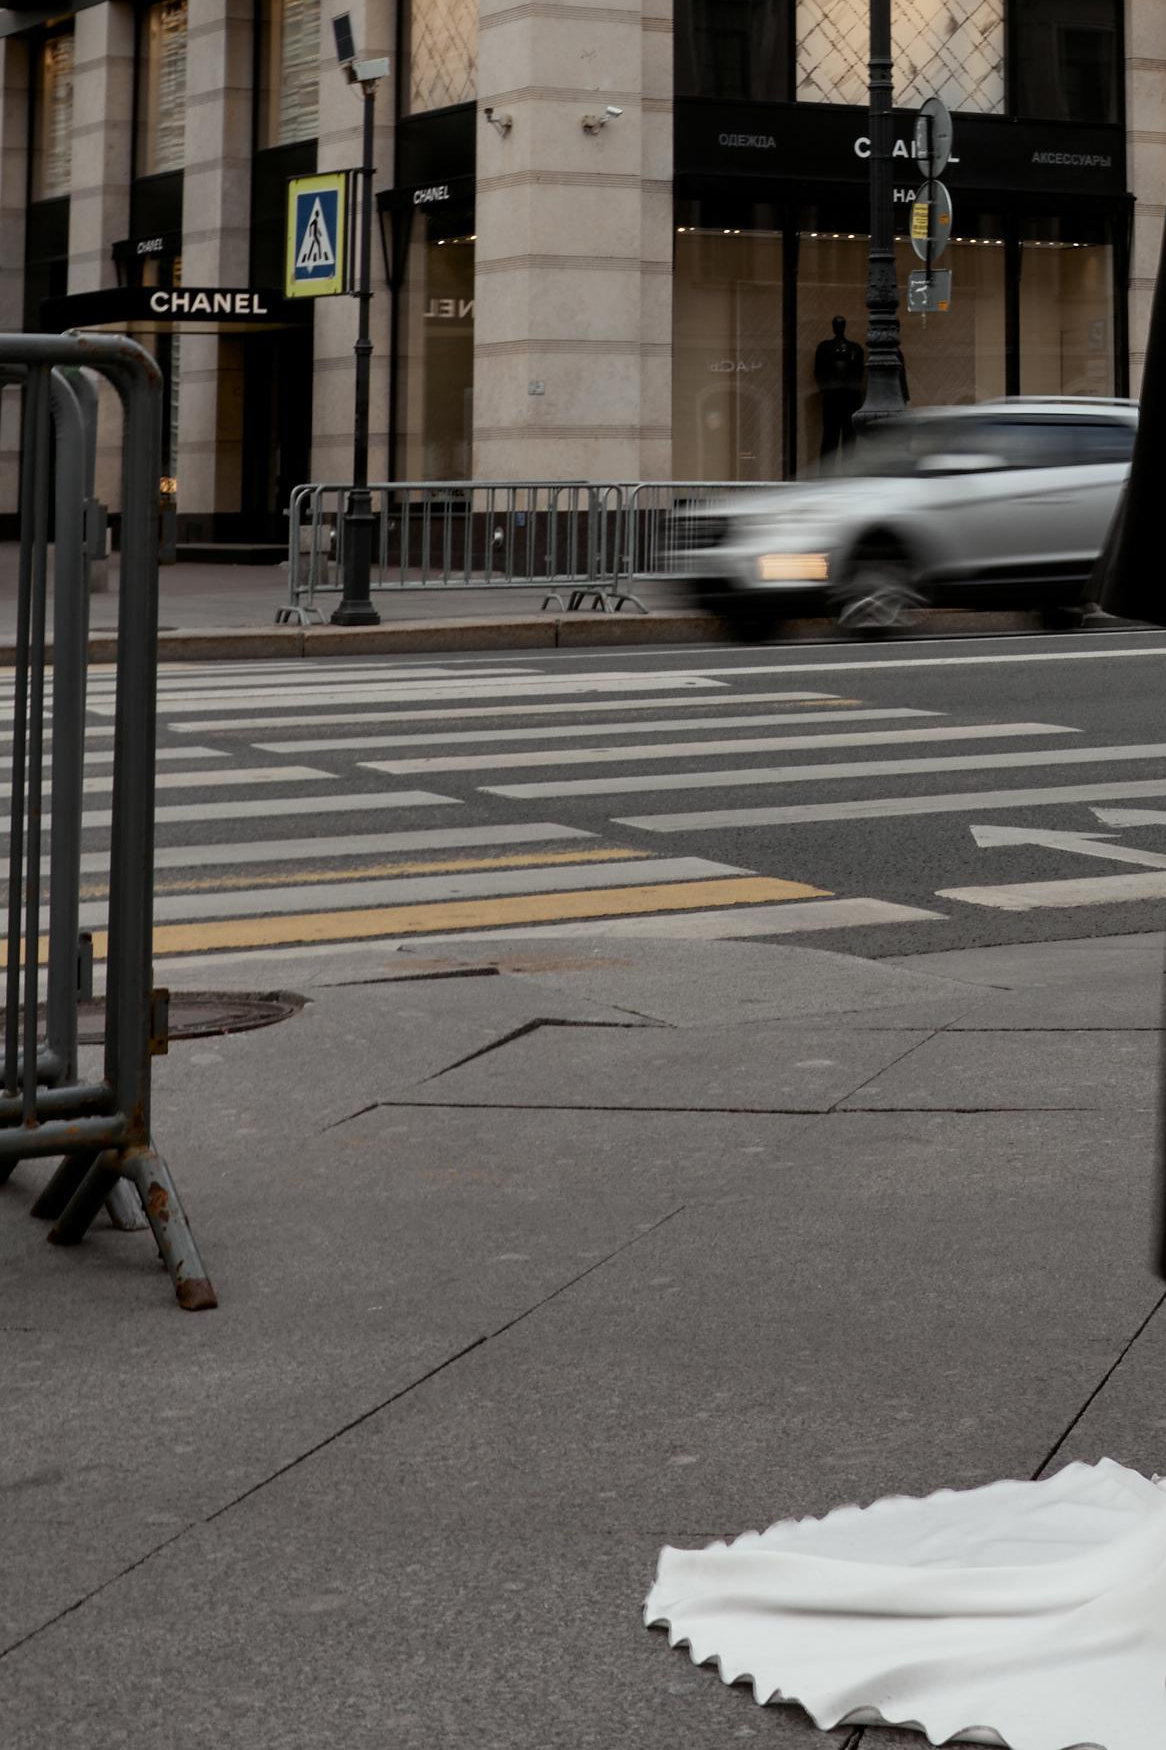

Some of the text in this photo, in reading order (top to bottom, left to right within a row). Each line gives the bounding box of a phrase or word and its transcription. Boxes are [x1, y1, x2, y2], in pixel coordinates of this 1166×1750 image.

[719, 133, 776, 148] ОДЕЖДА
[1031, 151, 1112, 167] АКСЕССУАРЫ
[413, 185, 450, 204] CHANEL
[150, 291, 268, 314] CHANEL
